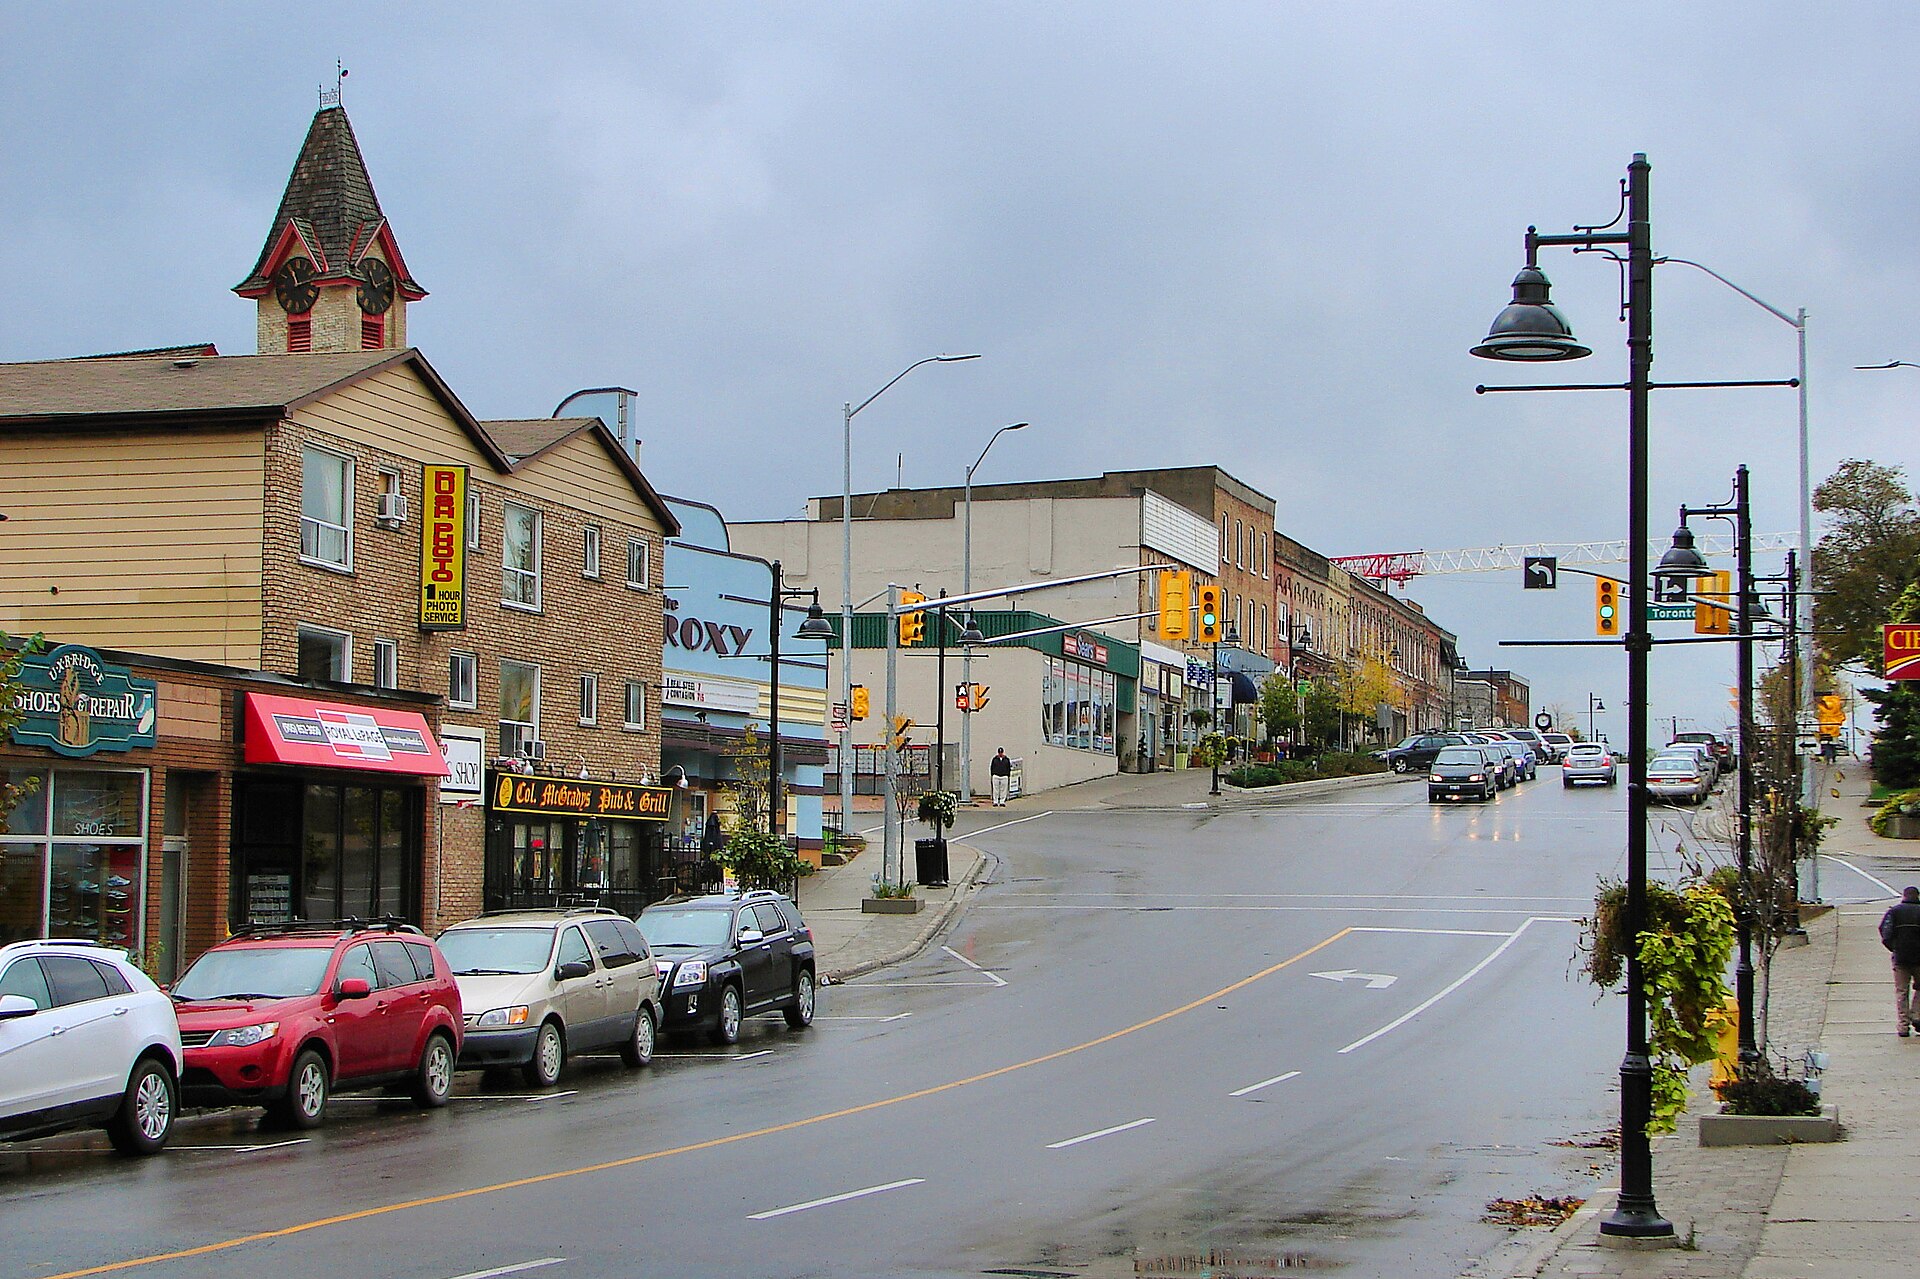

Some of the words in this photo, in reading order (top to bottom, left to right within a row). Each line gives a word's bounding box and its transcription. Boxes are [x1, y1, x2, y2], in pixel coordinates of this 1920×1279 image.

[431, 522, 455, 582] PHOTO
[424, 583, 436, 601] 1
[438, 590, 461, 602] HOUR
[426, 601, 458, 612] PHOTO
[423, 612, 459, 623] SERVICE
[89, 693, 136, 719] REPAIR
[325, 726, 355, 741] ROYAL
[455, 761, 479, 785] SHOP
[516, 781, 537, 804] Col.
[598, 787, 623, 813] Pub
[639, 791, 668, 813] Grill
[73, 822, 114, 836] SHOES
